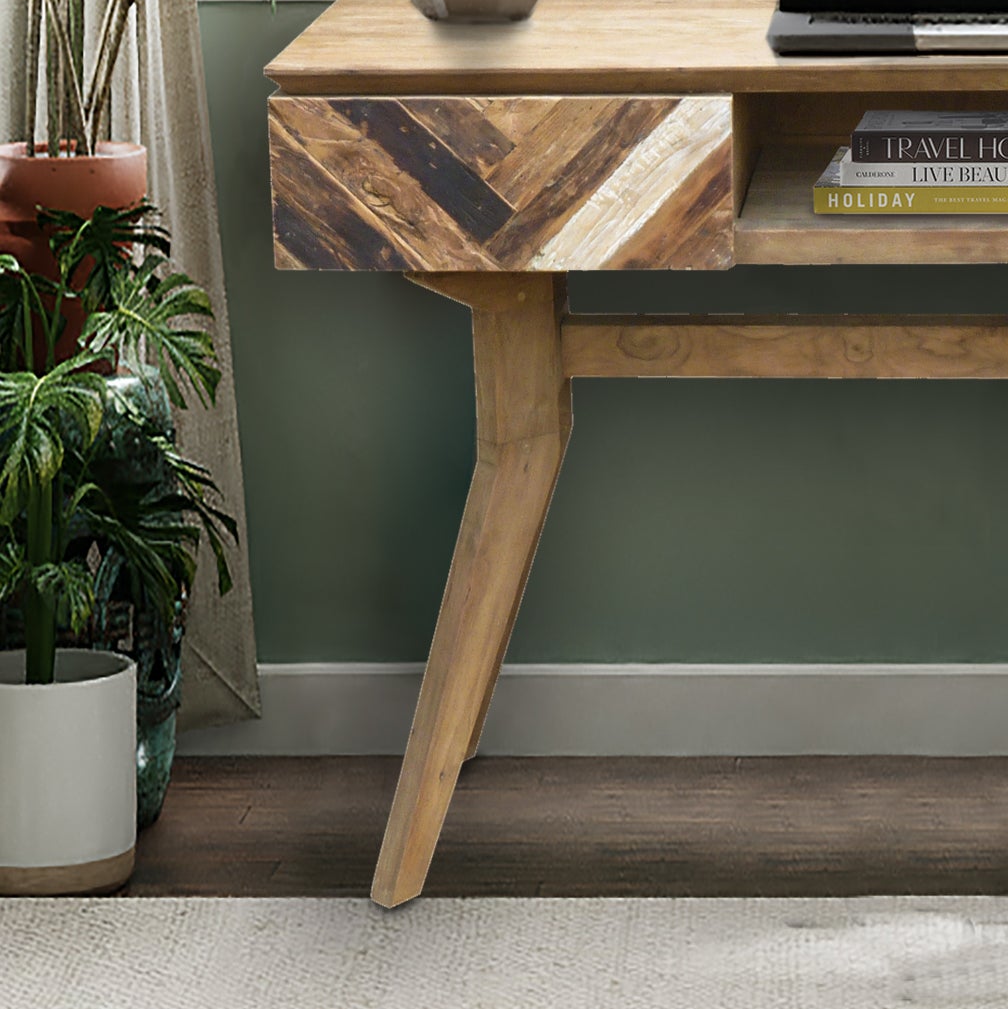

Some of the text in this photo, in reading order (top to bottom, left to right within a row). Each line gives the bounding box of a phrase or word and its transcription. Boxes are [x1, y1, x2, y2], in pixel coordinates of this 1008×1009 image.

[882, 137, 972, 159] TRAVEL
[912, 167, 954, 182] LIVE
[828, 193, 916, 208] HOLIDAY
